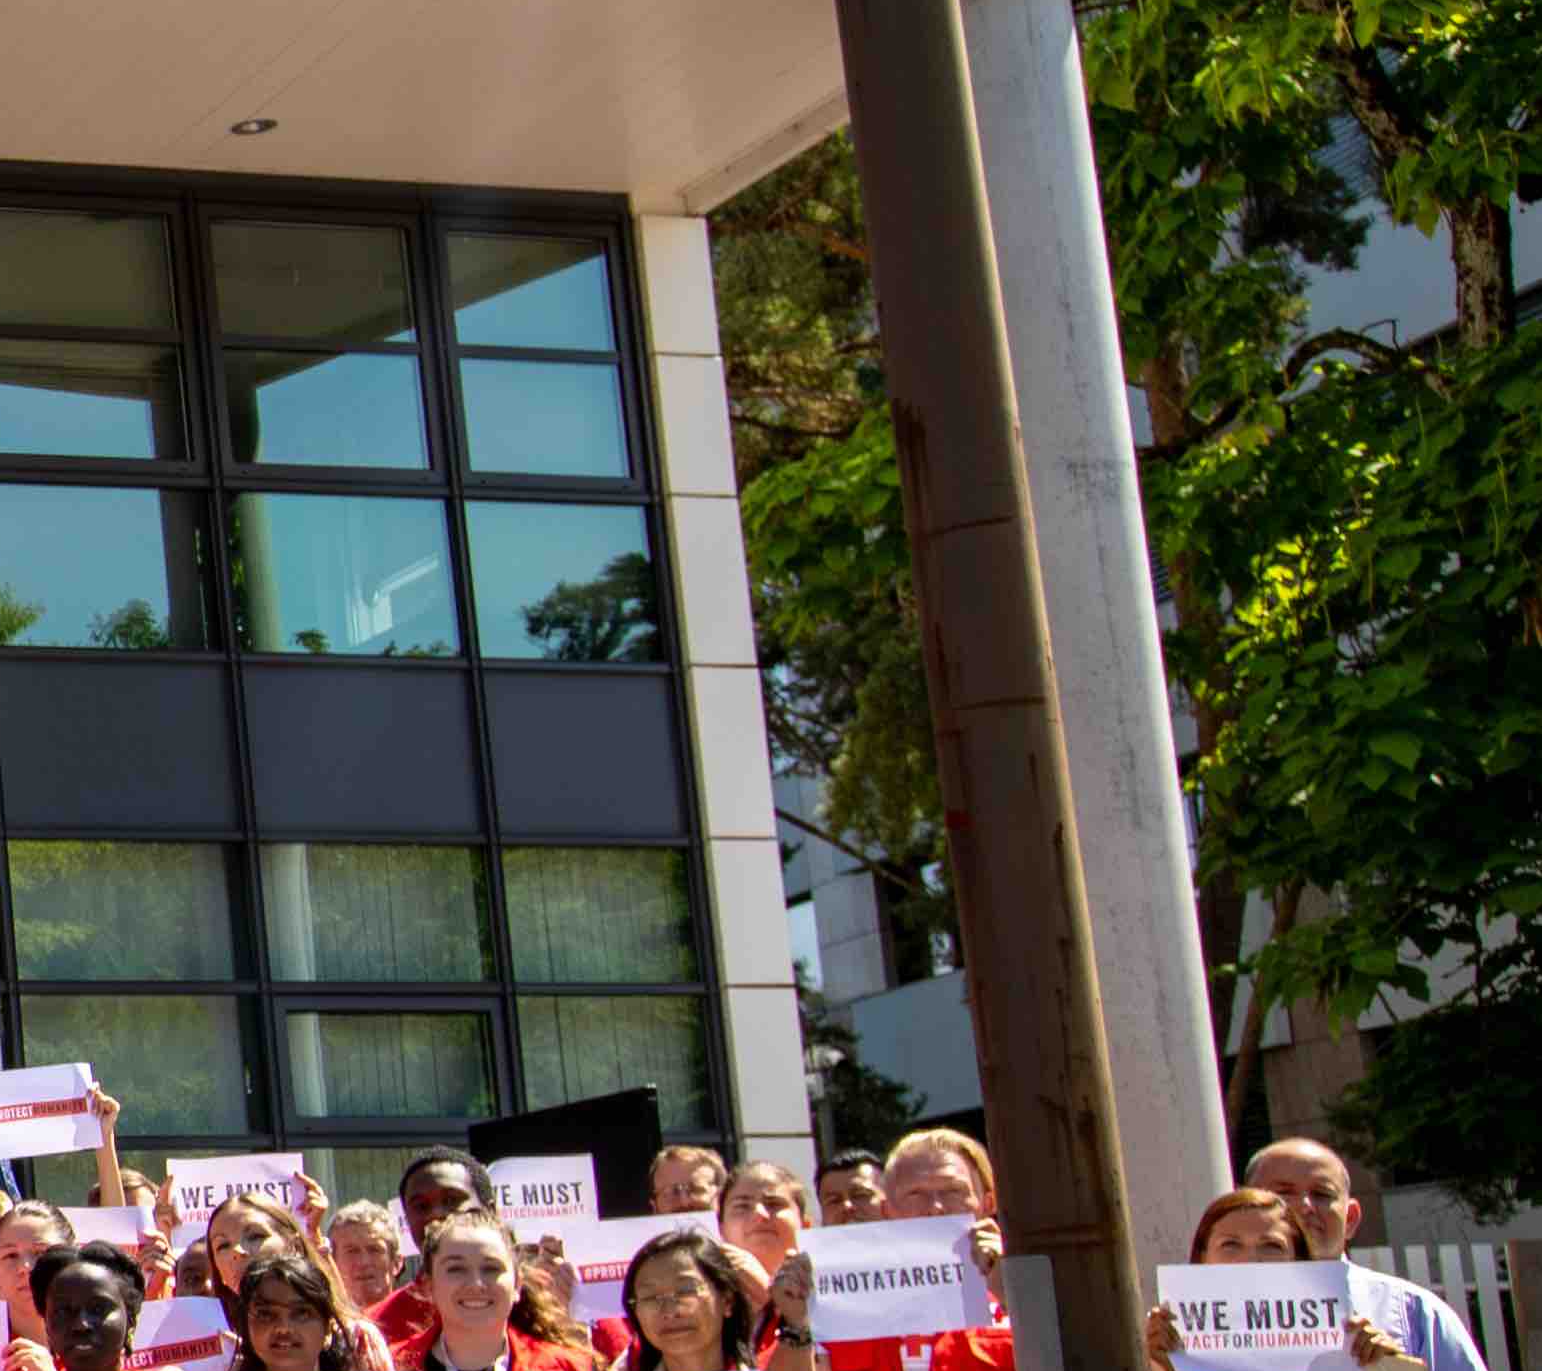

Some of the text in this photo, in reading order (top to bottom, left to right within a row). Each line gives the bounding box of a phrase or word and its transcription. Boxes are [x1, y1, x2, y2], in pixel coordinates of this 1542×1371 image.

[181, 1186, 216, 1209] WE
[522, 1182, 583, 1206] MUST
[817, 1262, 965, 1295] #NOTATARGET
[1180, 1298, 1340, 1331] WE MUST
